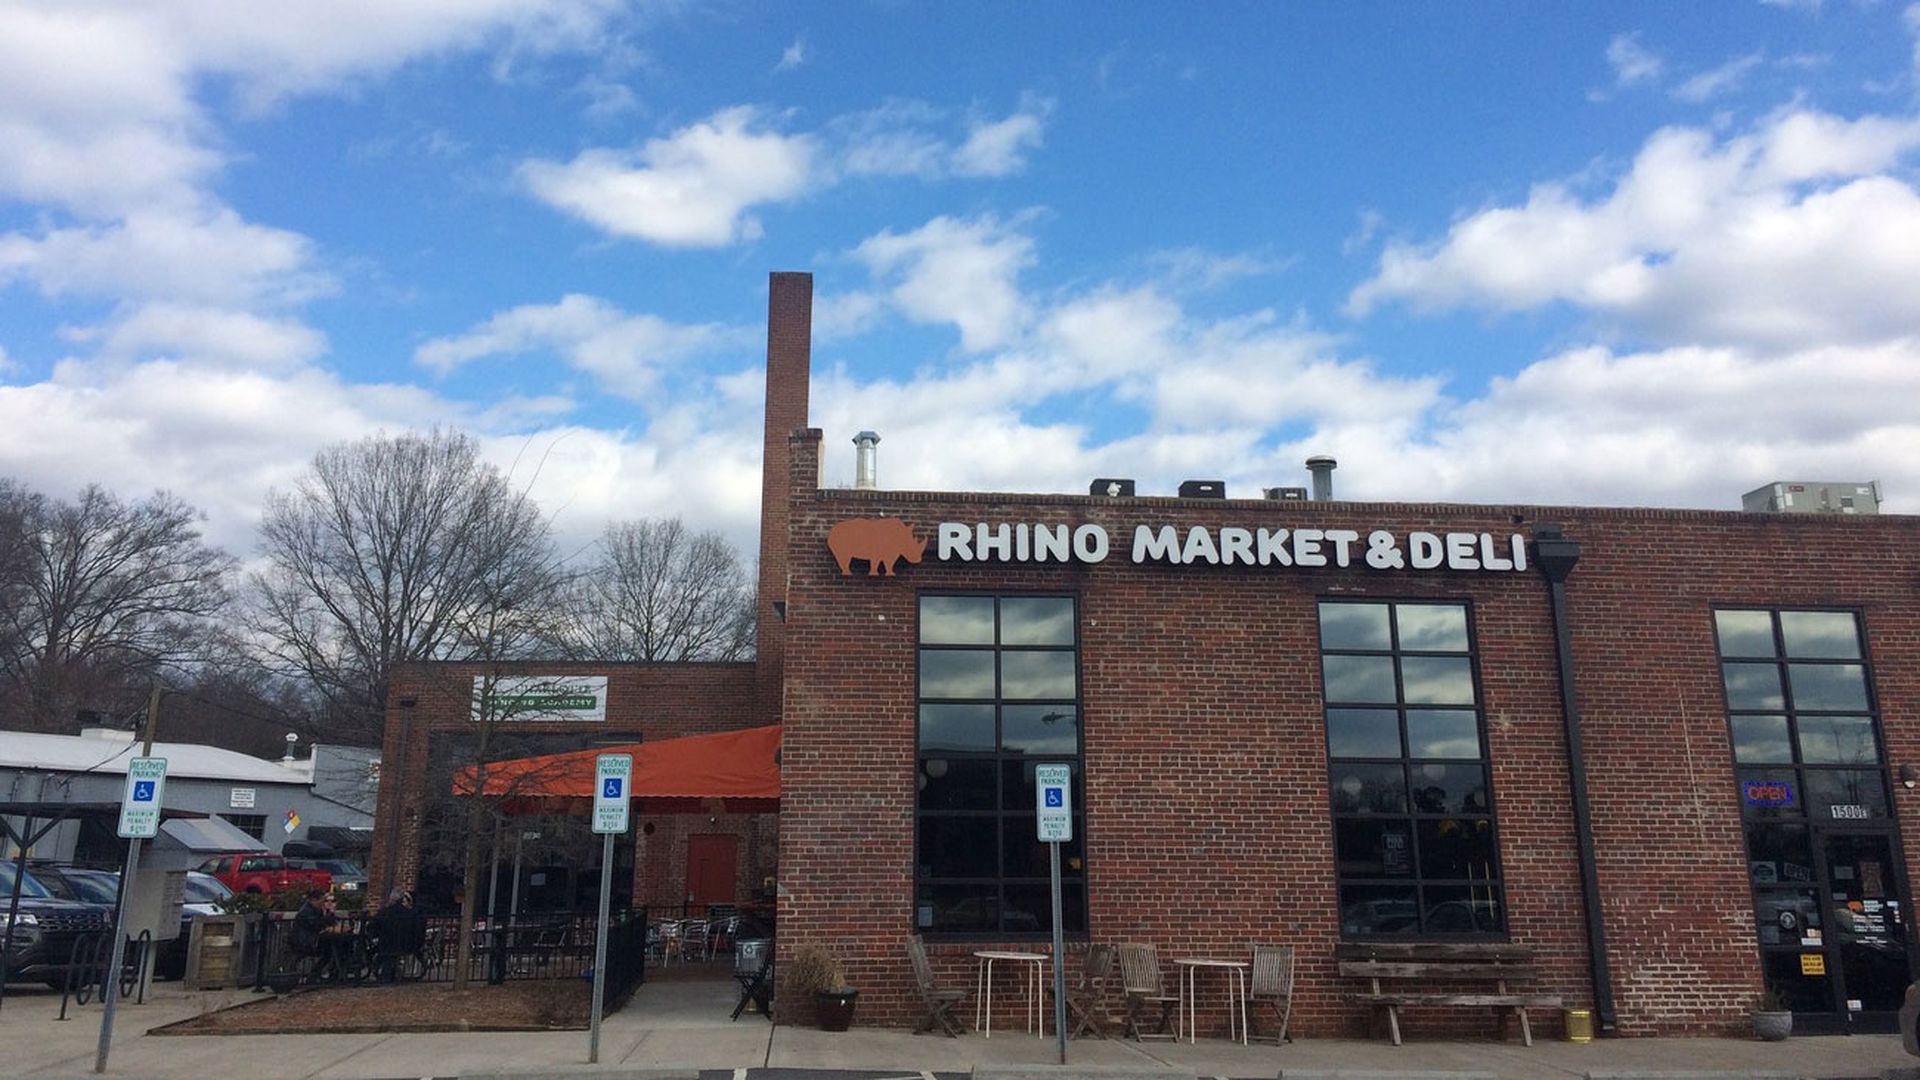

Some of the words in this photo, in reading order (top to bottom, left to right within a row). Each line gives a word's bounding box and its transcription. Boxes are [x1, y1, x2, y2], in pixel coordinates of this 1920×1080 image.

[937, 522, 1110, 564] RHINO
[1131, 524, 1360, 567] MARKET
[1365, 529, 1405, 571] &
[1408, 531, 1528, 572] DELI
[131, 761, 165, 770] RESERVED
[598, 759, 631, 768] RESERVED
[132, 770, 162, 778] PARKING
[600, 768, 627, 776] PARKING
[1039, 769, 1067, 777] RESERVED
[1748, 786, 1787, 800] OPEN
